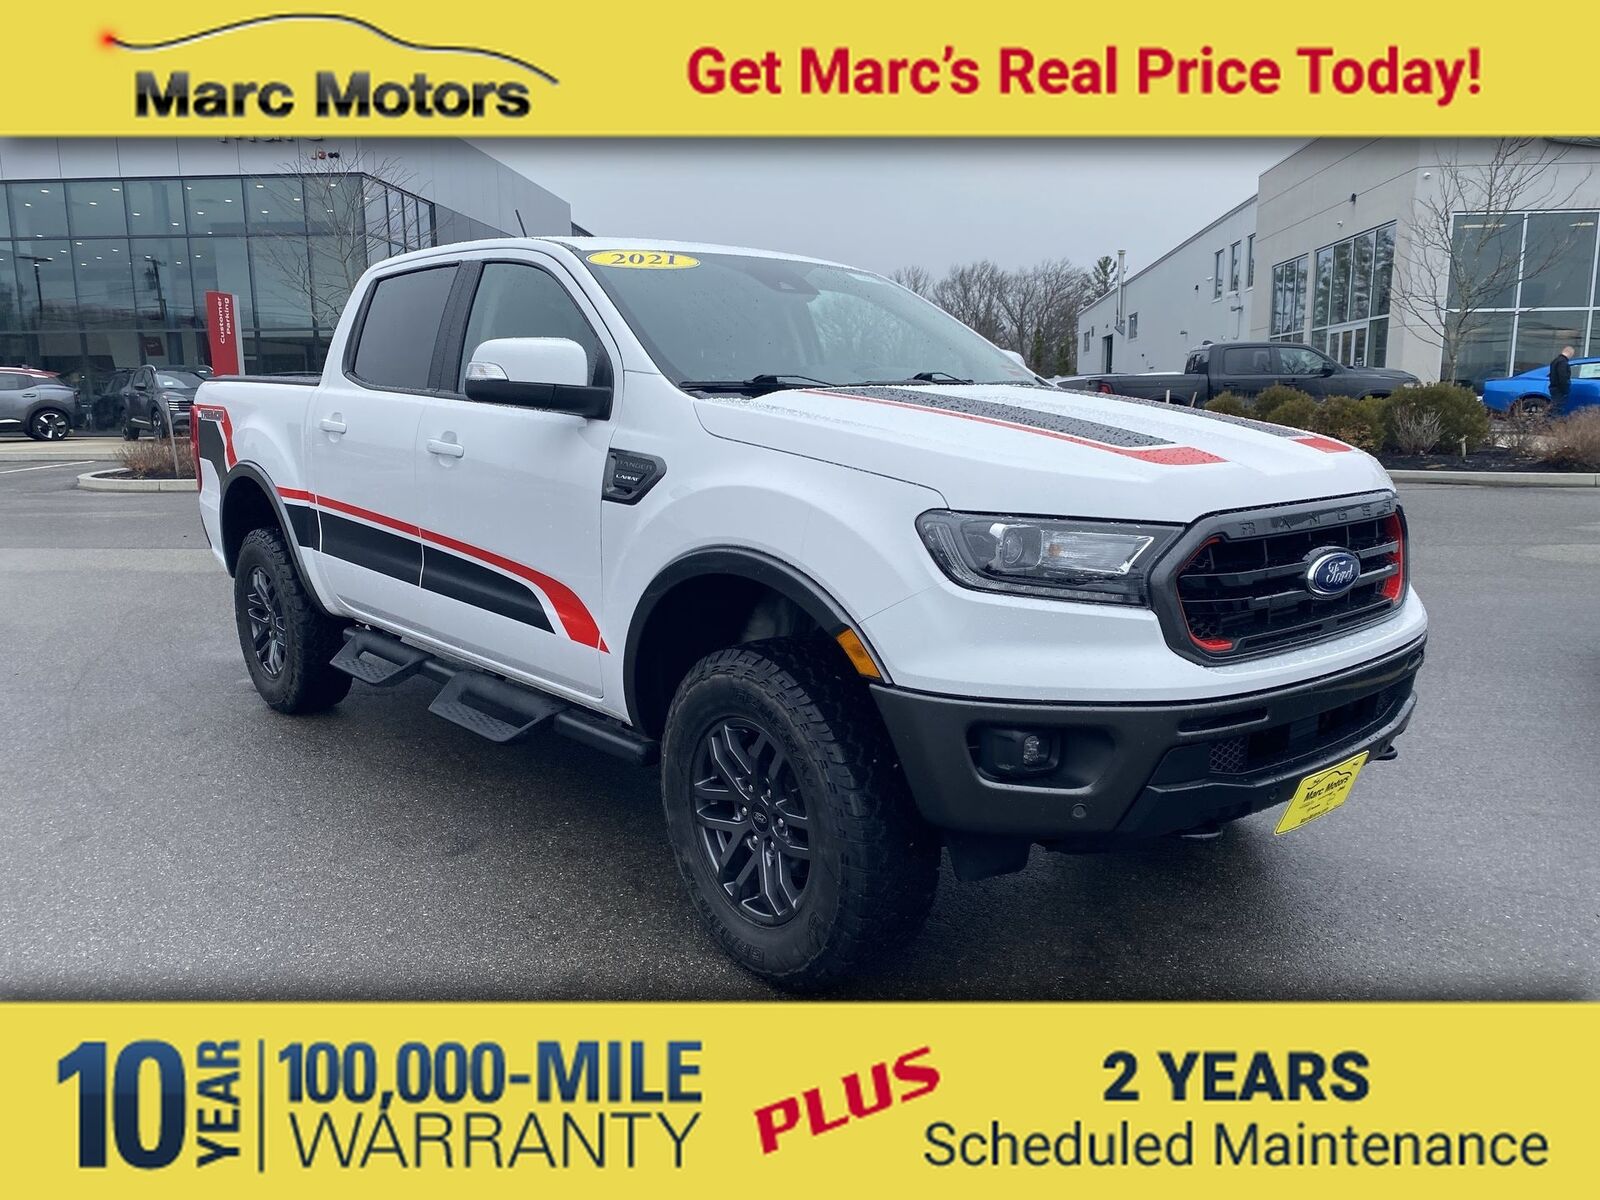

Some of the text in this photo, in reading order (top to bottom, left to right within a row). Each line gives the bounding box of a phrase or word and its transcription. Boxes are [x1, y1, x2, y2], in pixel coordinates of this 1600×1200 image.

[610, 253, 676, 265] 2021
[217, 296, 226, 344] Customer
[1240, 501, 1391, 536] RANGER
[1326, 560, 1354, 583] Ford
[1304, 788, 1325, 802] Marc
[1324, 775, 1350, 793] Motors
